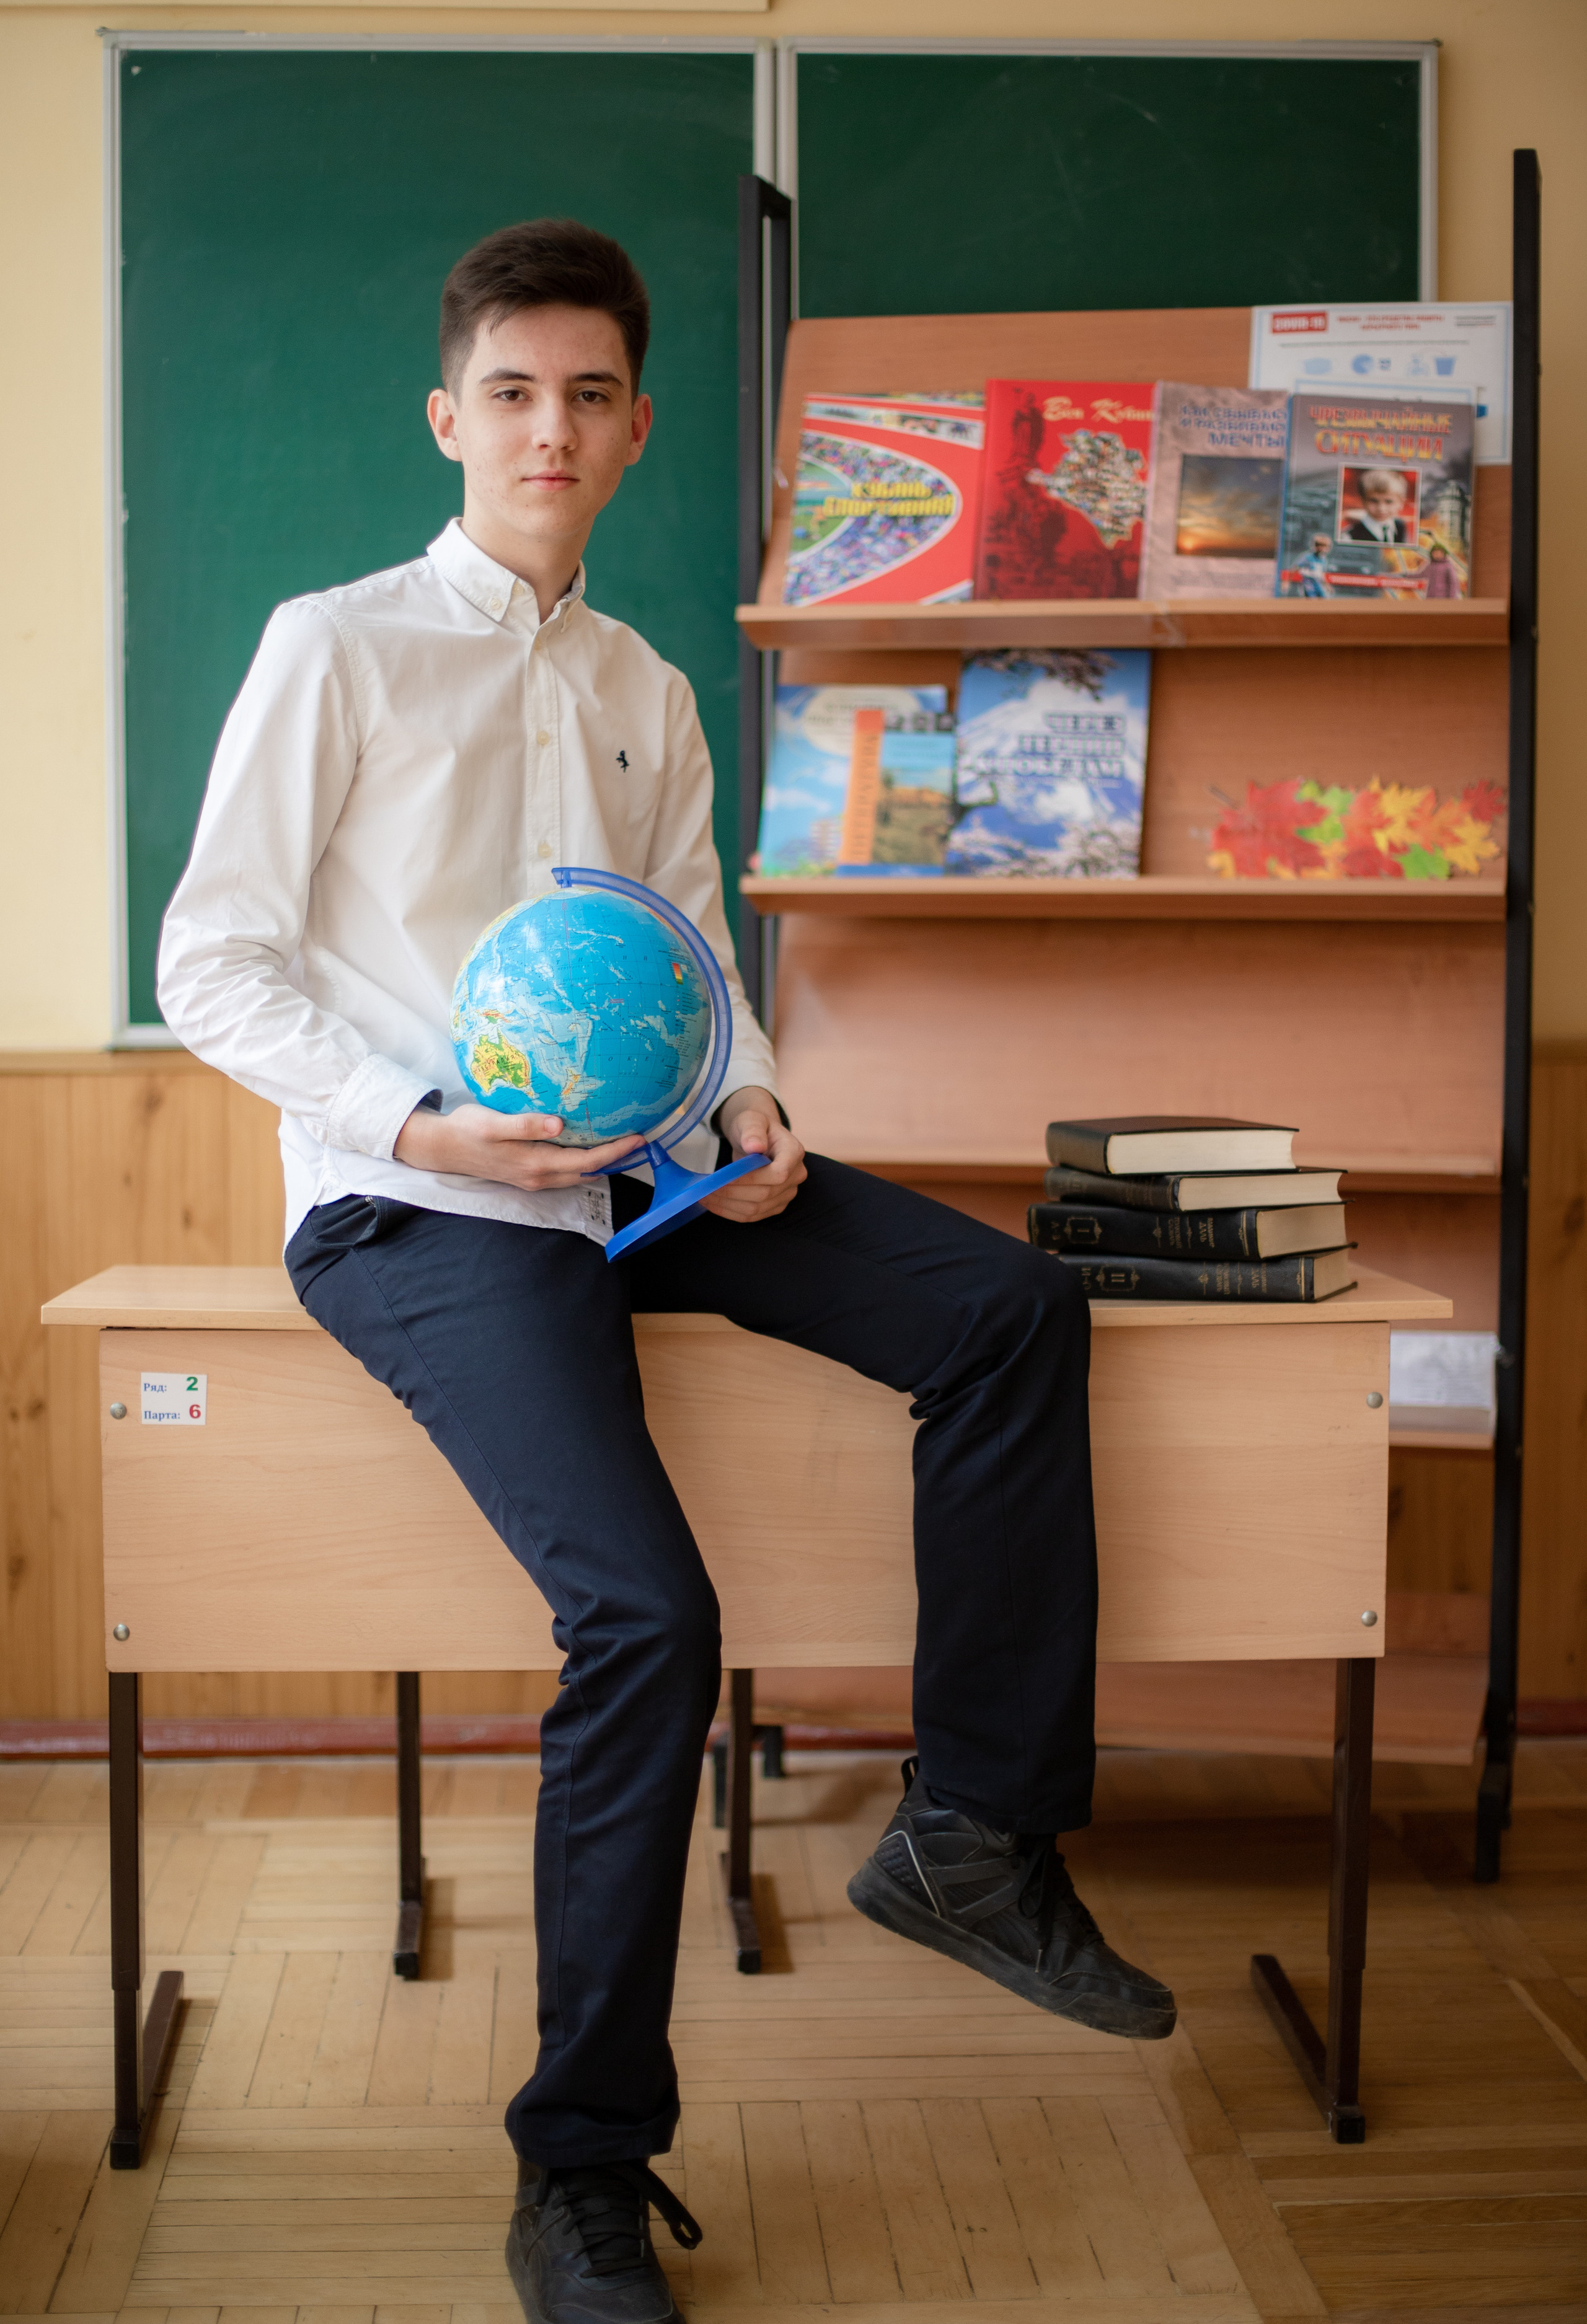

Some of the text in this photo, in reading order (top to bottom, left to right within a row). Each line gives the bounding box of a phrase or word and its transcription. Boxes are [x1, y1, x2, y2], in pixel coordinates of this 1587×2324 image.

[1309, 405, 1453, 434] ЧРЕЗВЫЧАЙНЫЕ
[1208, 432, 1286, 448] МЕЧТЫ
[1314, 429, 1443, 463] СИТУАЦИИ
[1199, 1221, 1207, 1243] ДАЛЬ
[1251, 1267, 1260, 1288] ДАЛЬ
[144, 1376, 198, 1393] Ряд: 2
[144, 1404, 201, 1422] Парта: 6
